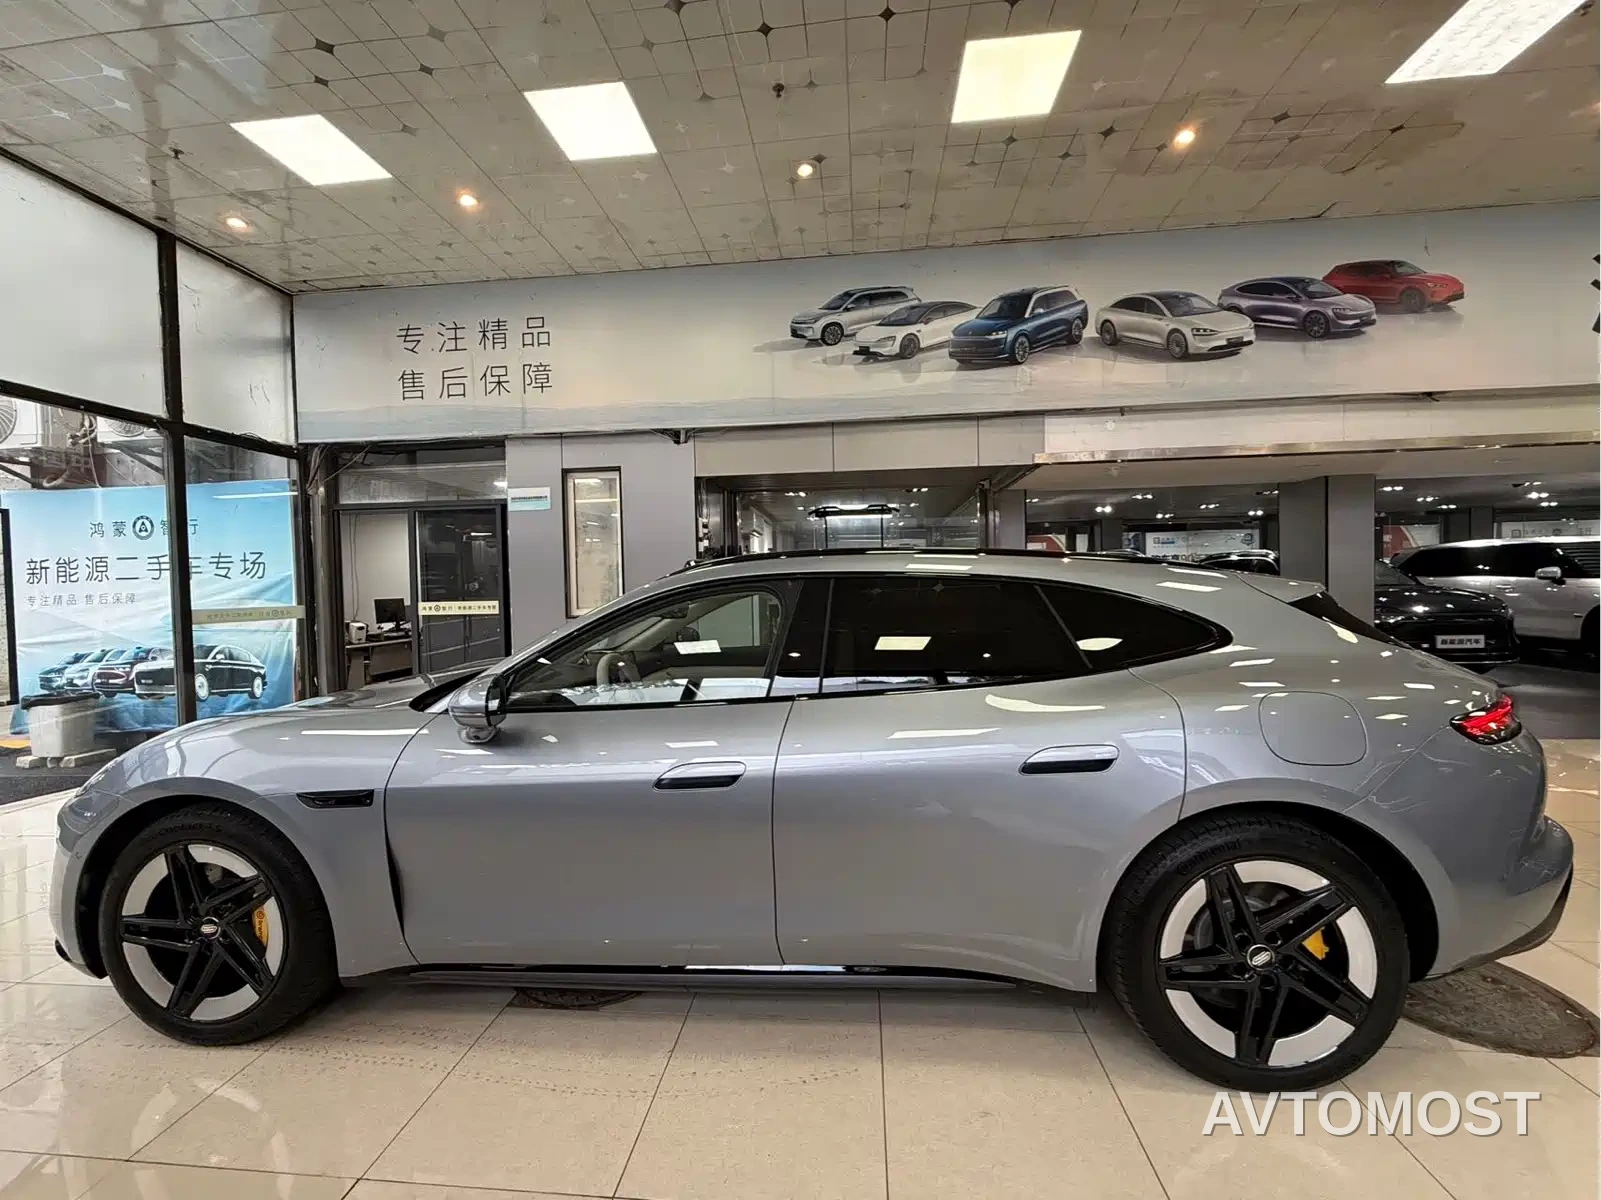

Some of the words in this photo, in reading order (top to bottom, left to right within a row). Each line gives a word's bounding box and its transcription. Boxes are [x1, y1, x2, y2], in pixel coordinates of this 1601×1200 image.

[396, 316, 551, 355] 专注精品
[397, 362, 553, 401] 售后保障
[89, 520, 127, 538] 鸿蒙
[26, 594, 77, 607] 专注精品
[85, 592, 136, 605] 售后保障
